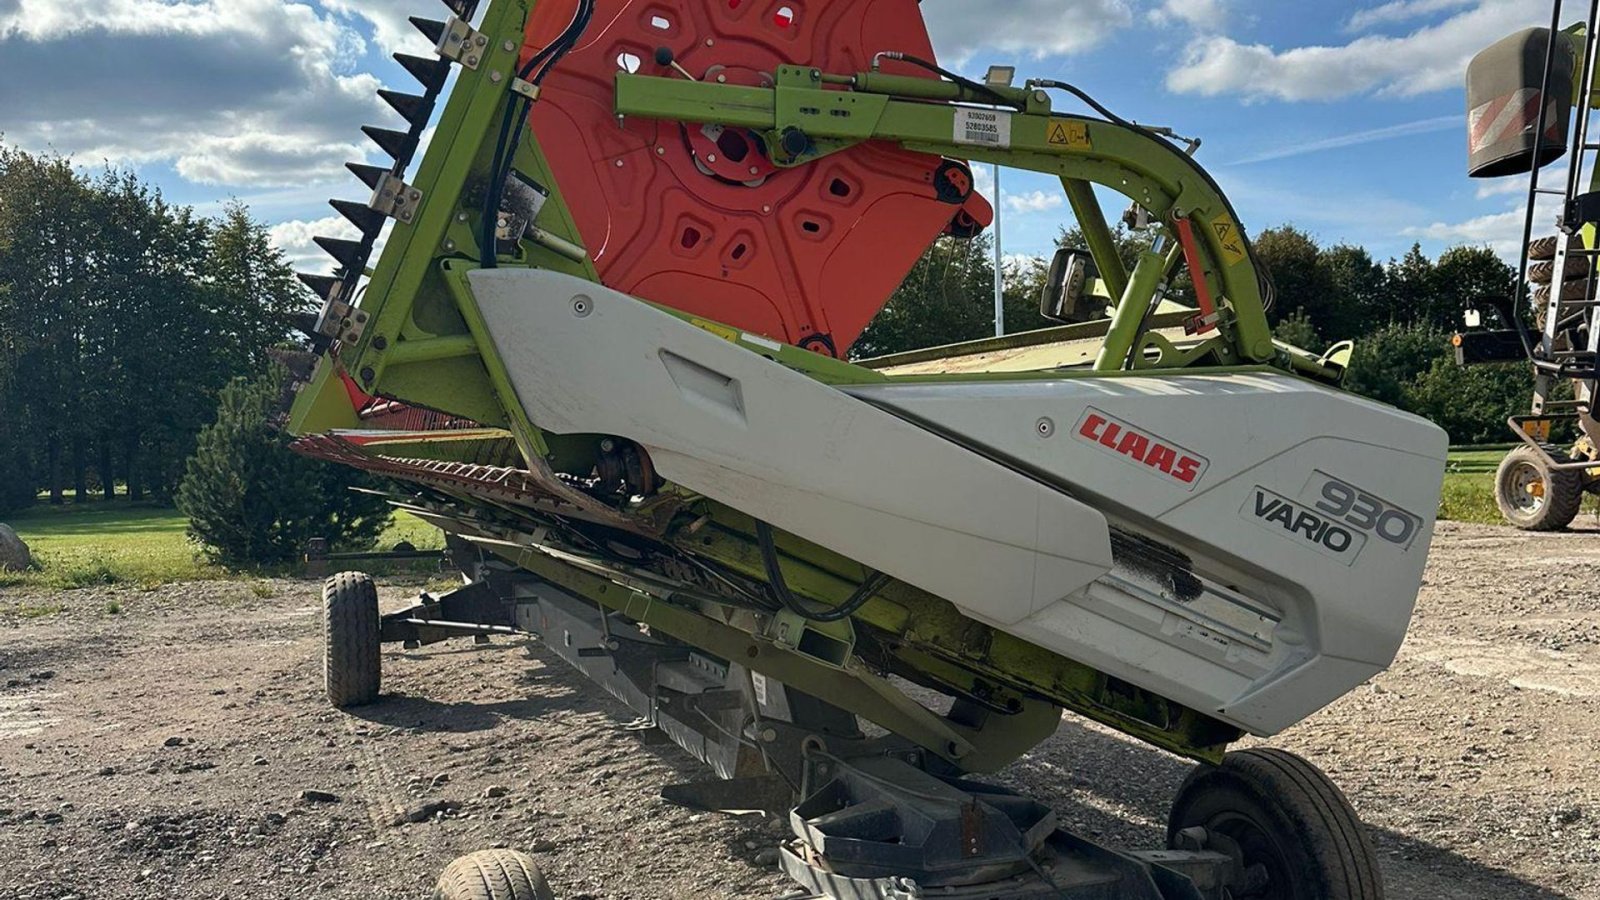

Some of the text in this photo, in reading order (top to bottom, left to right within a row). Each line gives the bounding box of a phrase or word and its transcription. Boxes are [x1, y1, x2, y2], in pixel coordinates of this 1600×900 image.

[1079, 414, 1201, 483] CLAAS
[1254, 491, 1353, 553] VARIO
[1315, 480, 1415, 544] 930
